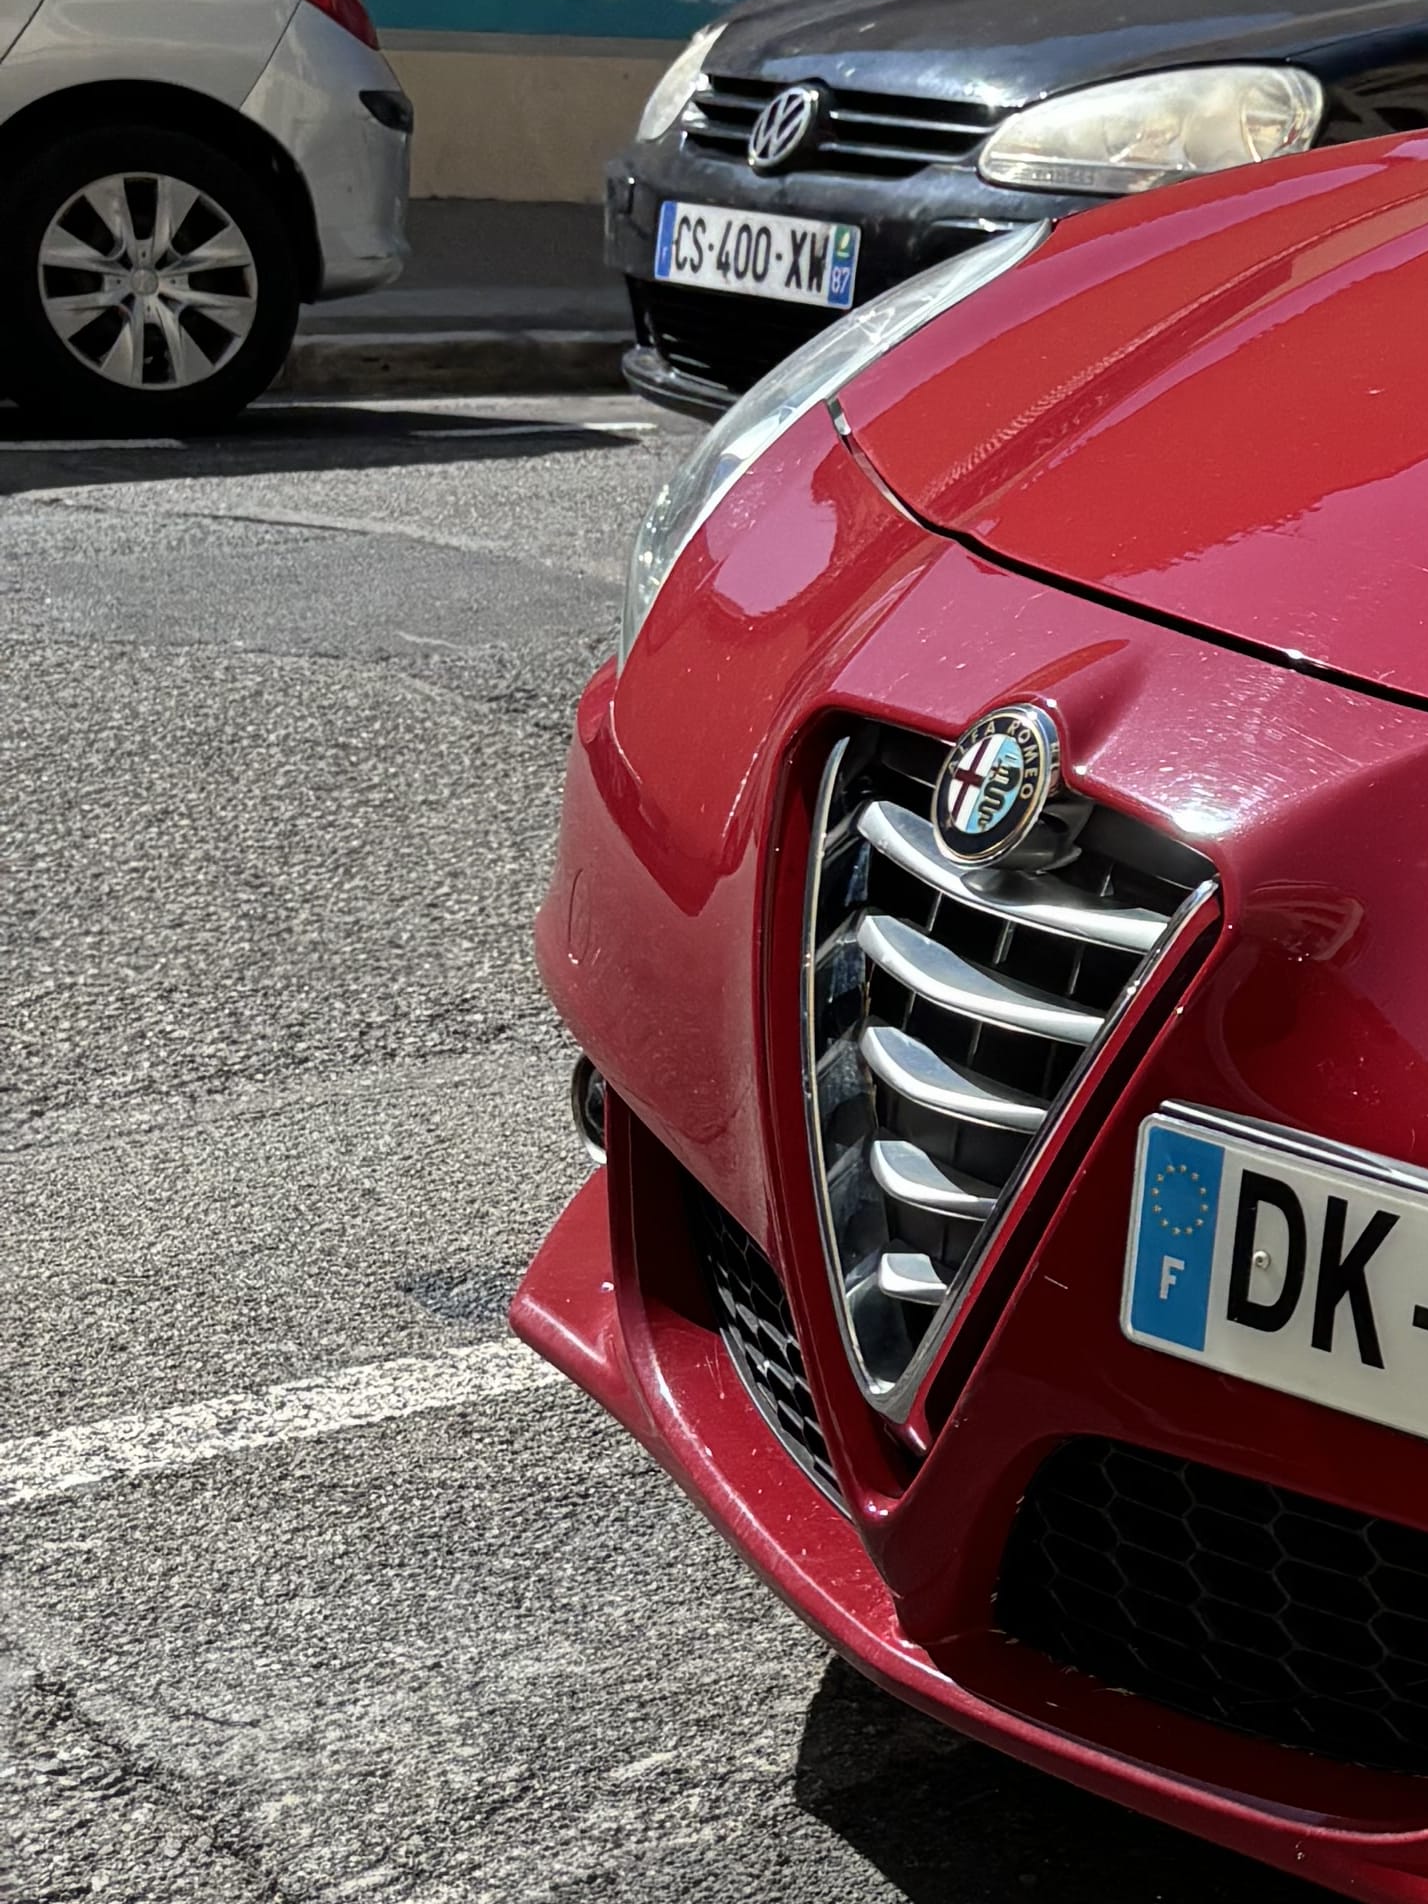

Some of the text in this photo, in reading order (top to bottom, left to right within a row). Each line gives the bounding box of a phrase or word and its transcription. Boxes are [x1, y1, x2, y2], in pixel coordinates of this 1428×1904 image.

[831, 266, 850, 294] 87
[1006, 718, 1039, 800] ROMEO
[1158, 1253, 1187, 1301] F
